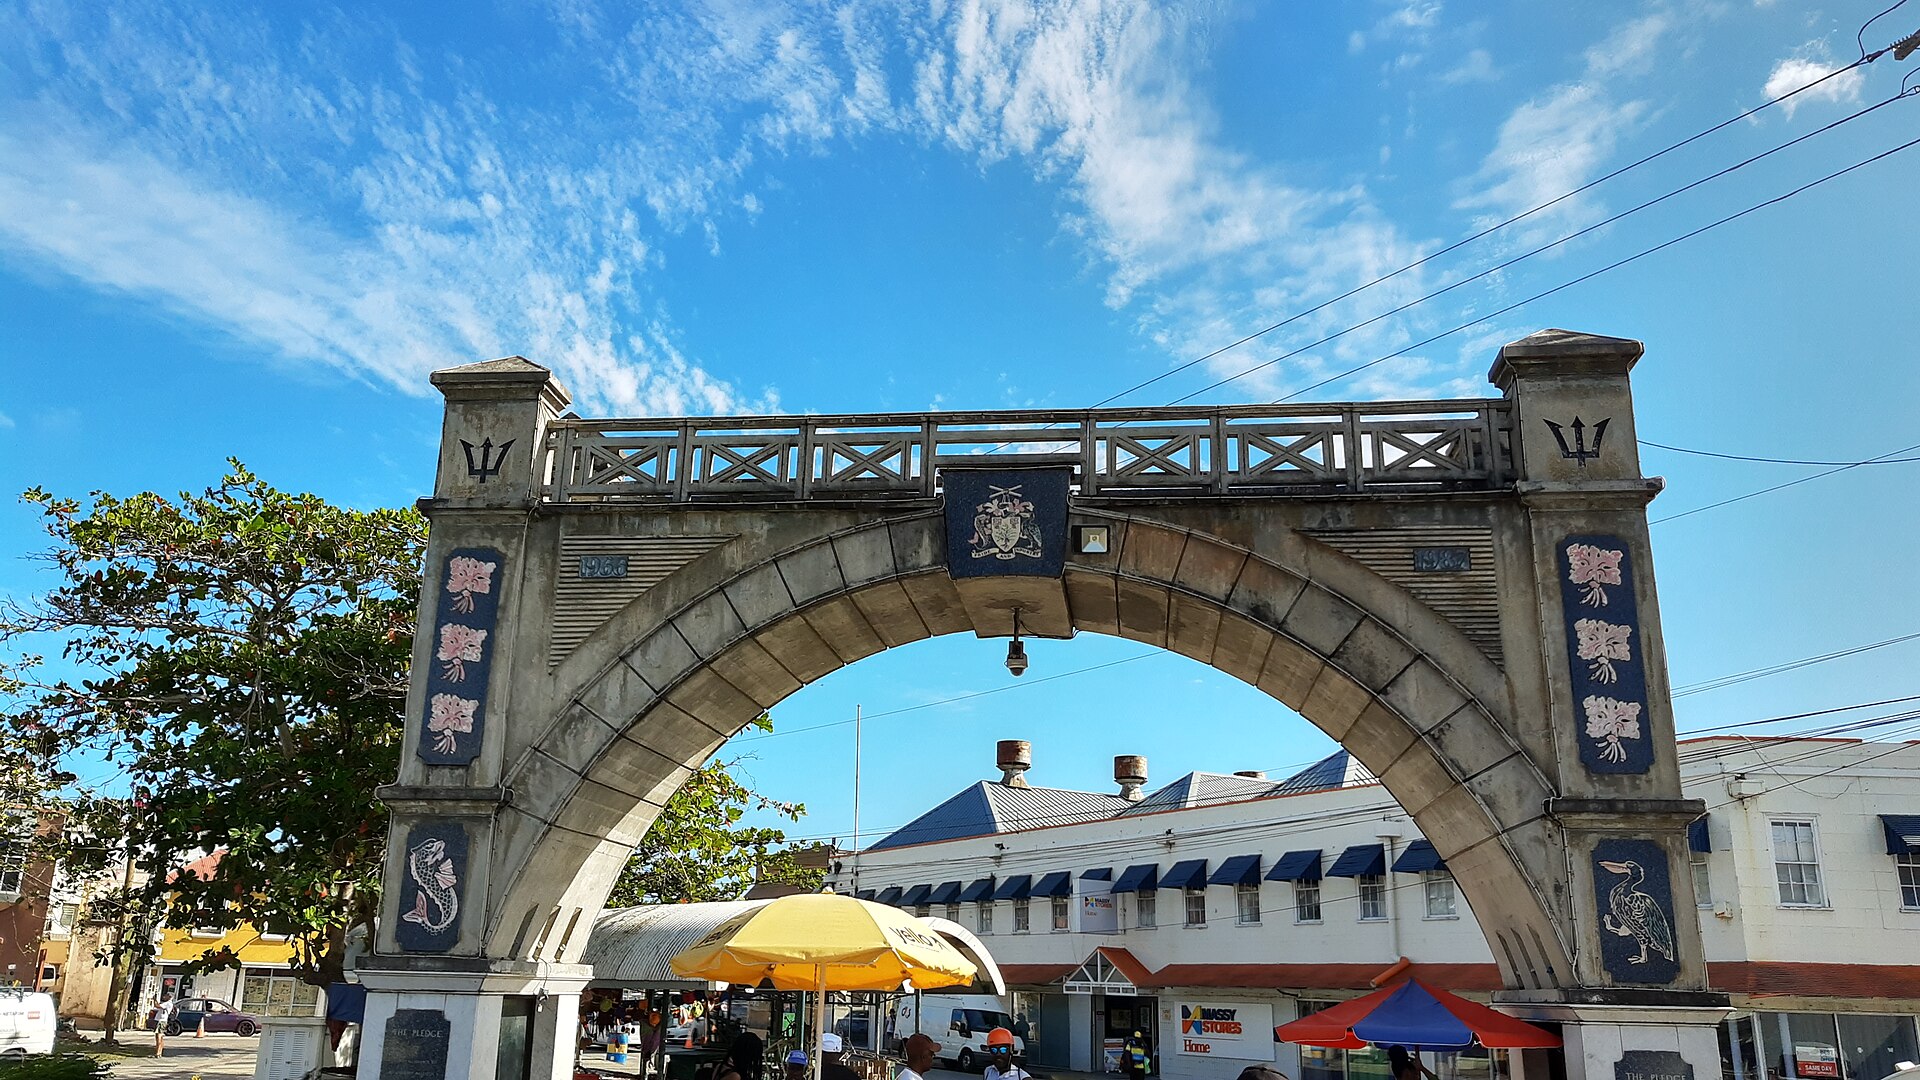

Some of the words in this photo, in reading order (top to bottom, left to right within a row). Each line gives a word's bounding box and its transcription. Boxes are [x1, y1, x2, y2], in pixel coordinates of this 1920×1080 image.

[581, 556, 626, 576] 1966
[889, 926, 933, 946] yello
[1201, 1008, 1237, 1021] MASSY
[392, 1028, 407, 1036] THE
[412, 1029, 444, 1038] PLEDGE
[1203, 1021, 1242, 1034] STORES
[1183, 1039, 1210, 1053] Home
[1626, 1072, 1644, 1080] THE
